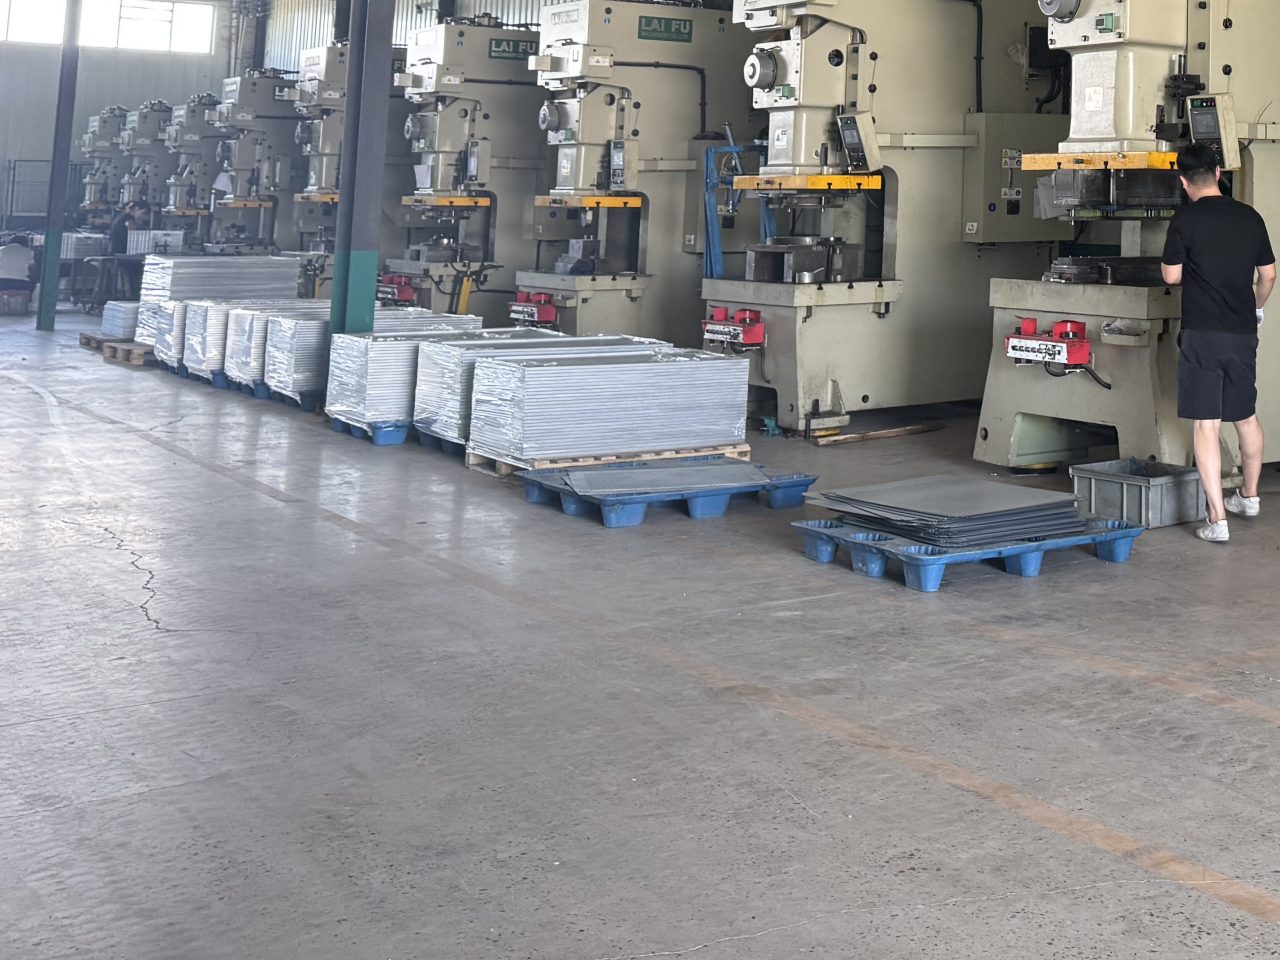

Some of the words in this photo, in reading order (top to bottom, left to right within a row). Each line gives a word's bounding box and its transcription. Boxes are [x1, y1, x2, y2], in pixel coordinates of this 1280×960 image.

[641, 18, 665, 32] LAI
[672, 20, 690, 33] FU
[491, 40, 513, 52] LAI
[519, 42, 536, 53] FU
